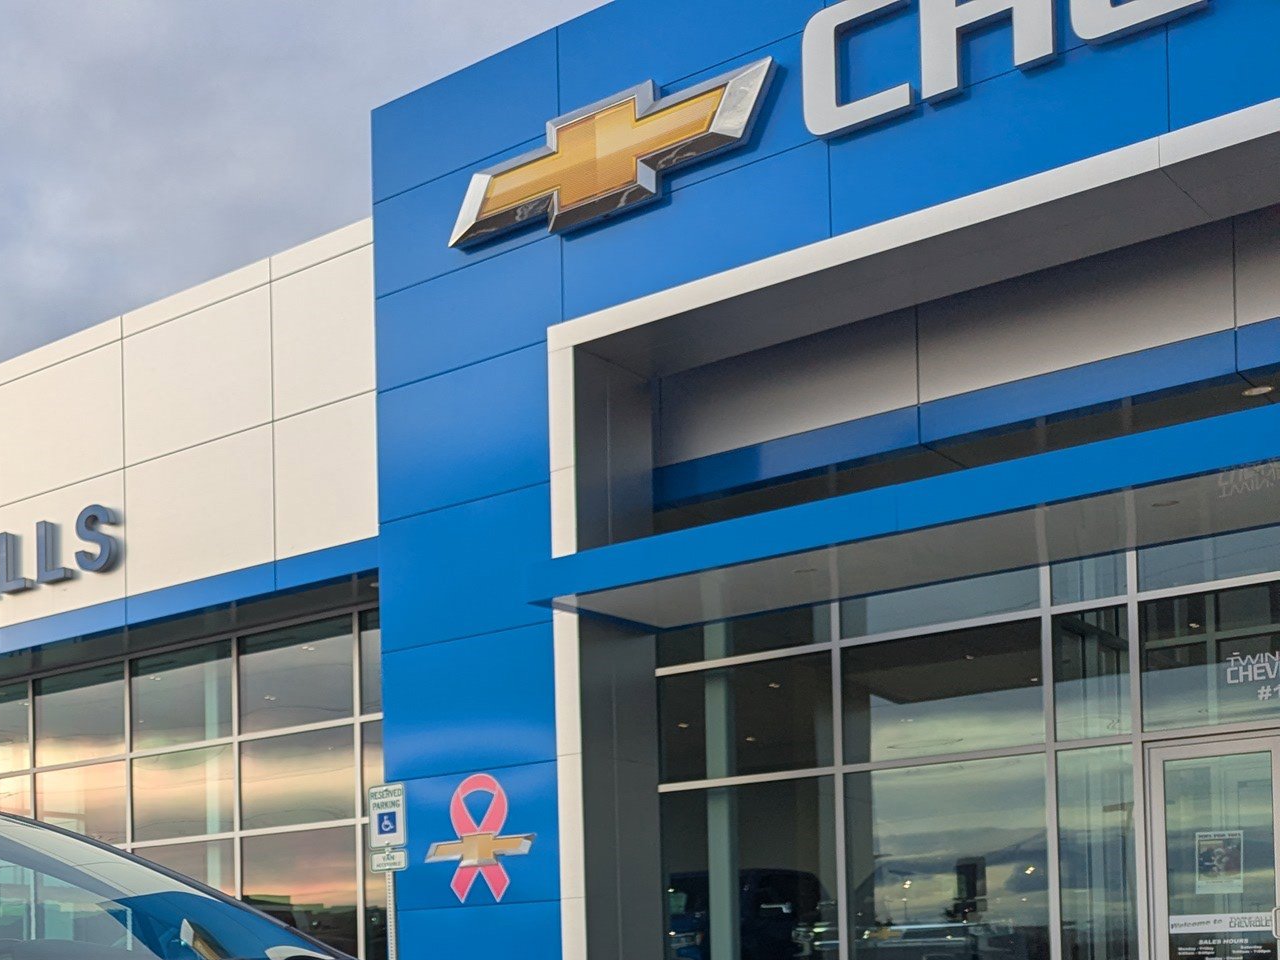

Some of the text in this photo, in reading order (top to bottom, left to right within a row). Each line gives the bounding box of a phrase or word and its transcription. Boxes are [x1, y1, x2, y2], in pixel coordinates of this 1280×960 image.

[370, 788, 402, 800] RESERVED
[372, 800, 401, 811] PARKING
[382, 854, 395, 862] VAN
